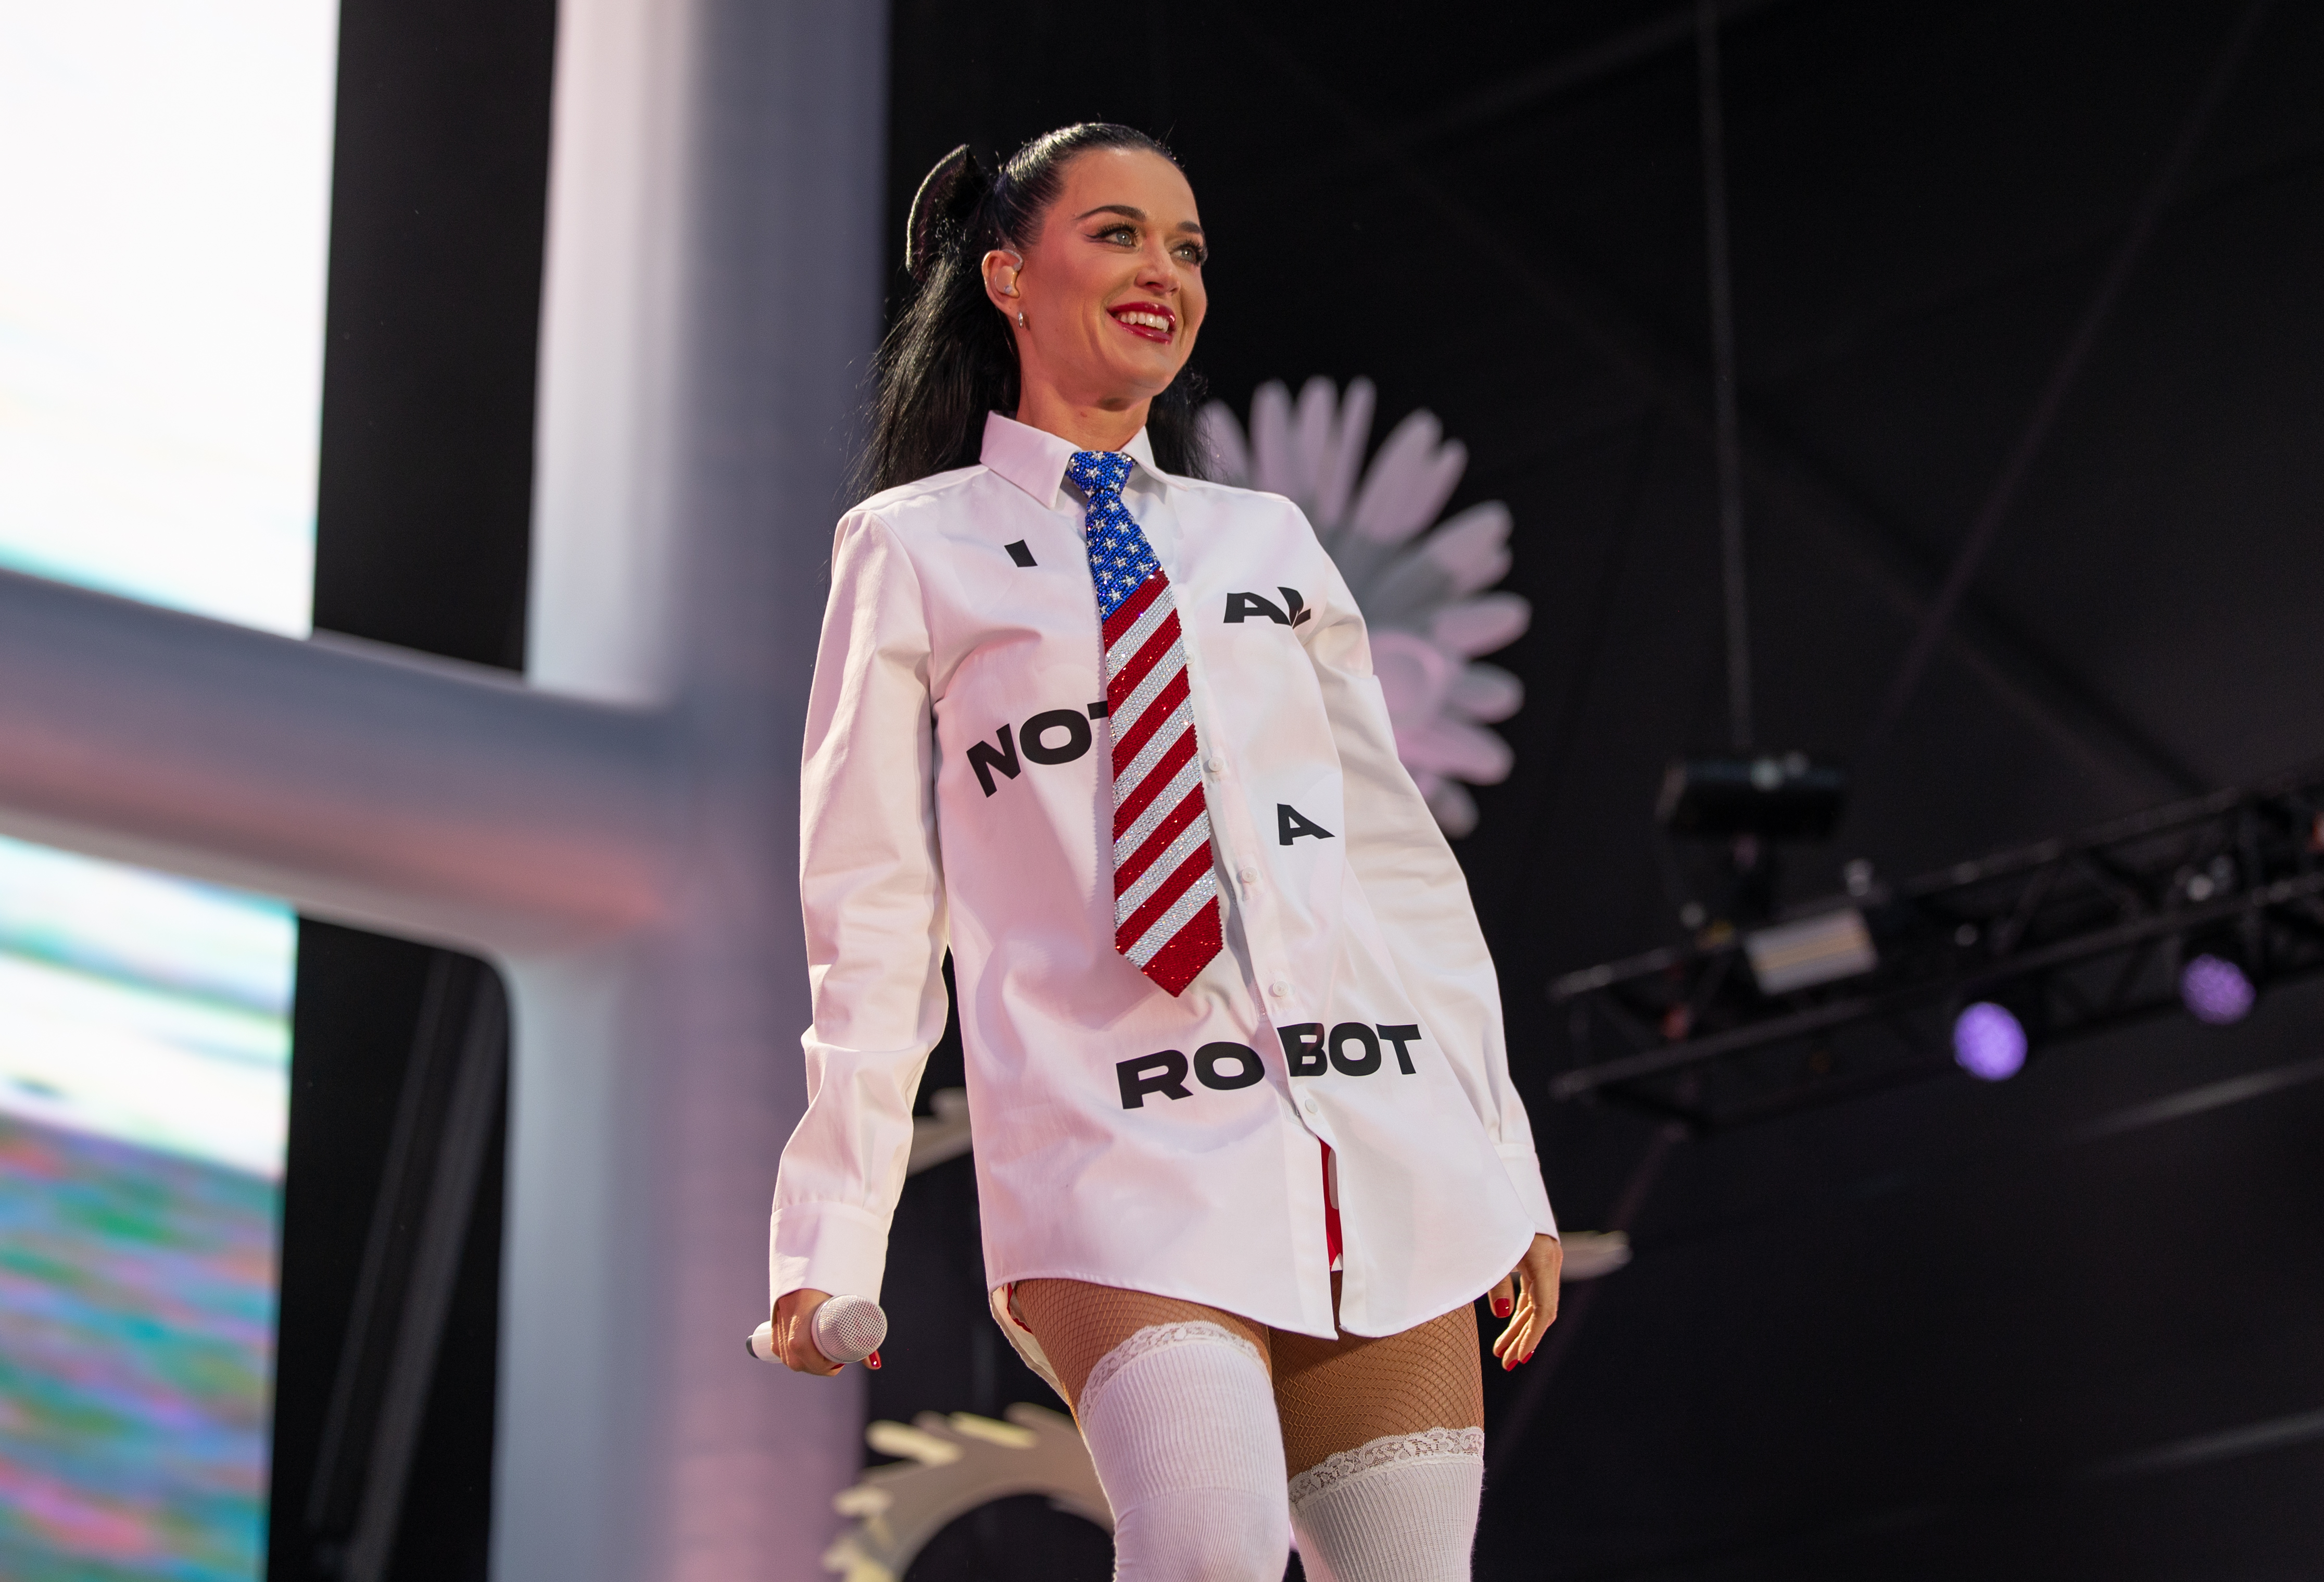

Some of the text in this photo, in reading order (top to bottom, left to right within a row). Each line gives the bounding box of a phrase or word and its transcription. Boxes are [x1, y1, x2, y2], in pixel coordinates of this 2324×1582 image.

[1004, 539, 1038, 568] I
[1277, 803, 1336, 846] A
[1116, 1022, 1422, 1110] ROBOT
